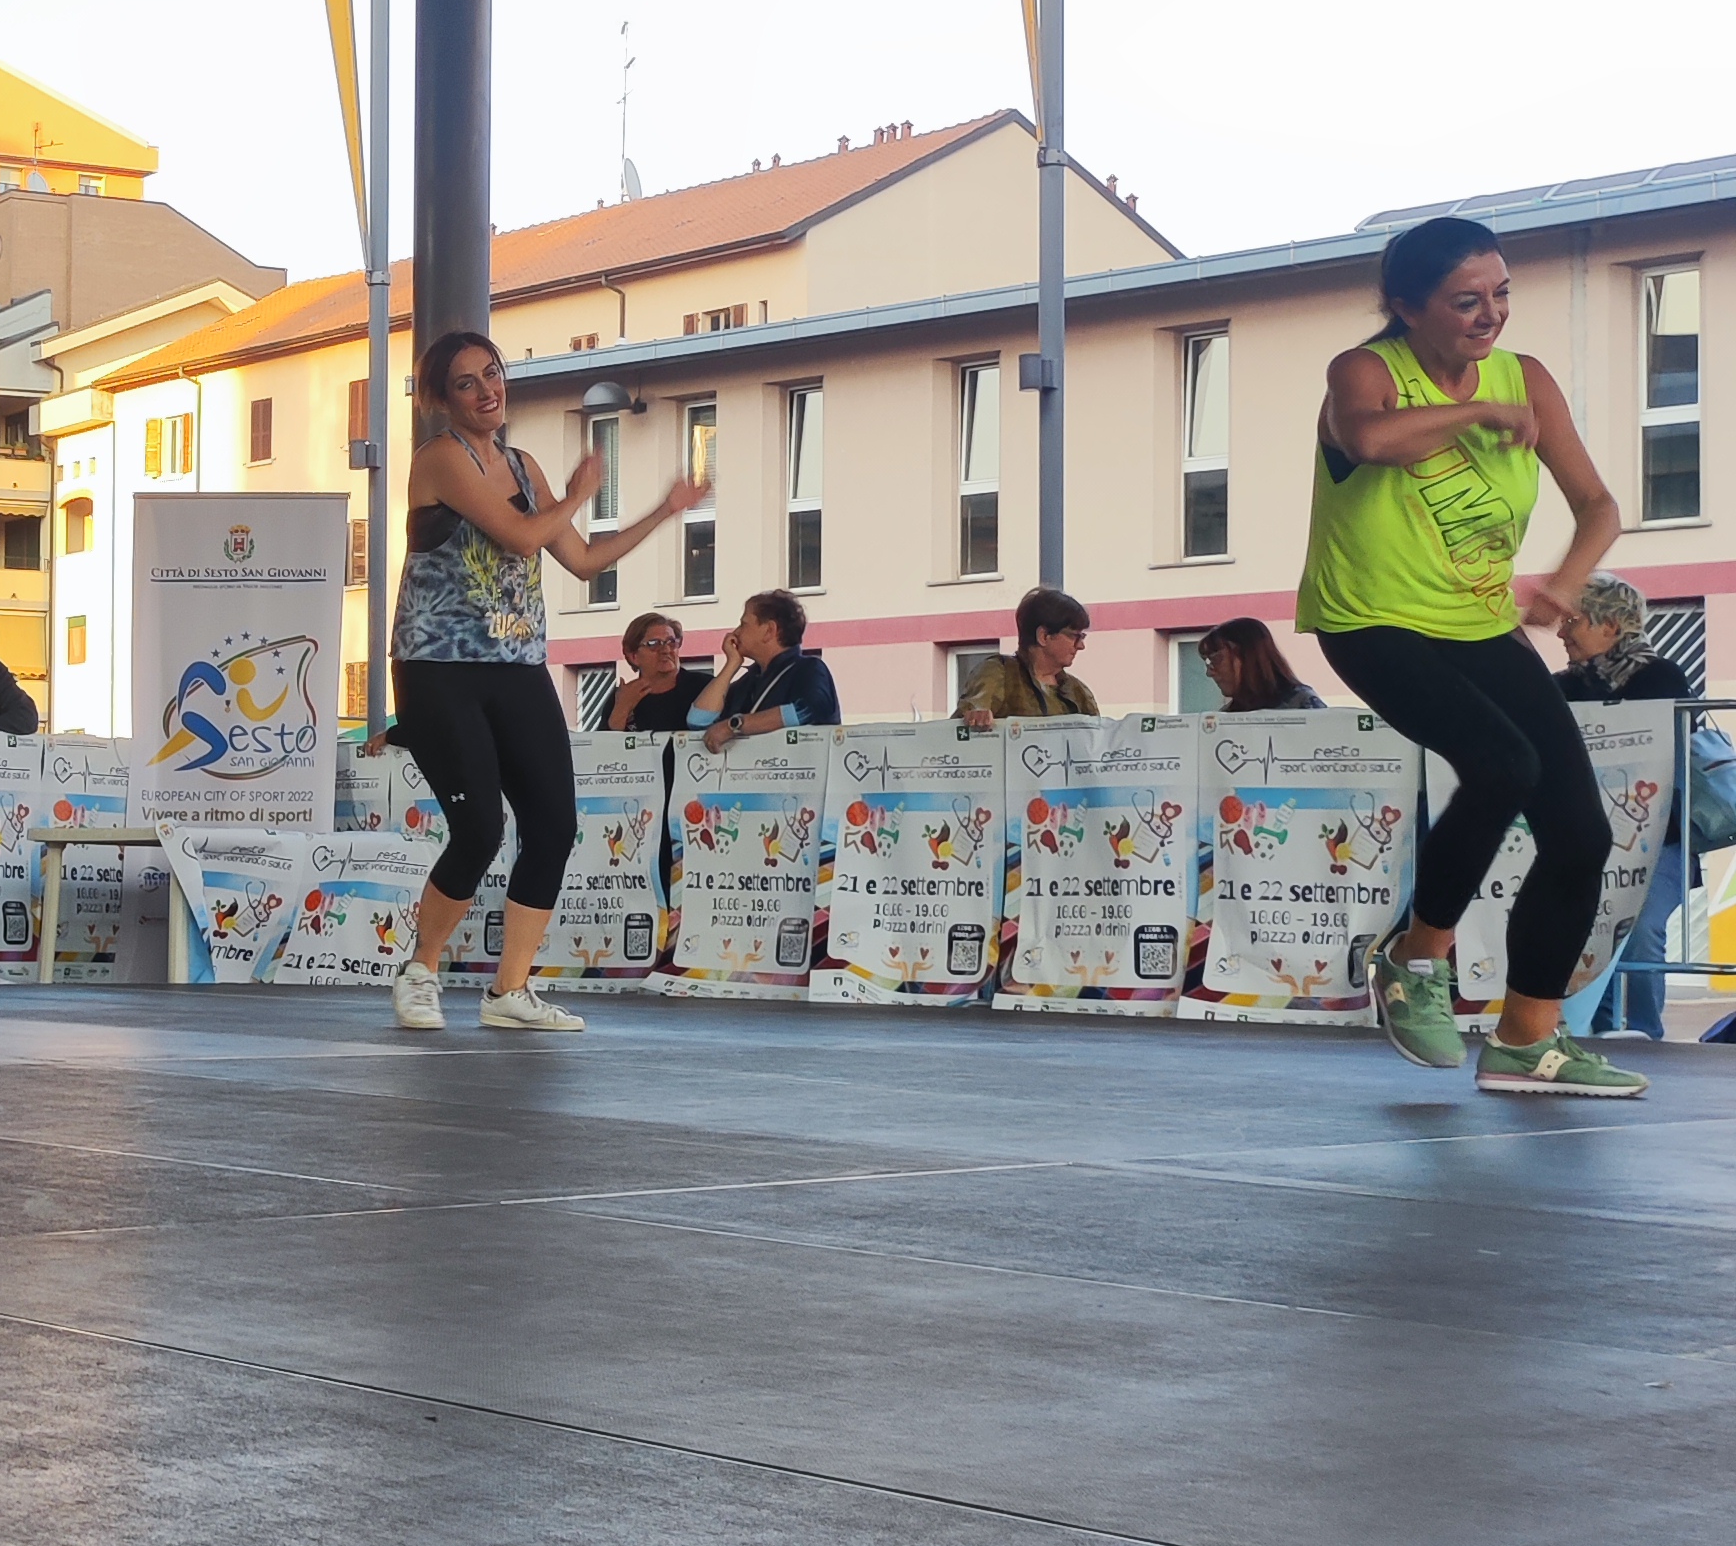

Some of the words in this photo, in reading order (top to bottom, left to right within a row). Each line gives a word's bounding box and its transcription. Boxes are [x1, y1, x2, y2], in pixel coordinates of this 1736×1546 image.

[1314, 746, 1359, 757] festa
[110, 765, 130, 775] fest
[141, 790, 201, 802] EUROPEAN
[204, 791, 227, 802] CITY
[230, 791, 246, 802] OF
[249, 791, 285, 802] SPORT
[287, 791, 314, 802] 2022
[142, 807, 188, 821] Vivere
[191, 811, 199, 821] a
[204, 808, 245, 822] ritmo
[249, 808, 264, 822] di
[266, 808, 313, 825] sport!
[71, 866, 78, 881] e
[80, 865, 94, 881] 22
[96, 865, 123, 883] sette
[566, 873, 583, 890] 22
[586, 872, 647, 890] settembre
[686, 871, 702, 889] 21
[706, 874, 714, 889] e
[718, 872, 734, 890] 22
[738, 873, 811, 892] settembre
[837, 874, 860, 893] 21
[866, 878, 877, 895] e
[882, 876, 898, 895] 22
[900, 877, 984, 897] settembre
[1026, 877, 1043, 896] 21
[1049, 880, 1058, 896] e
[1062, 877, 1079, 896] 22
[1084, 875, 1175, 896] settembre
[1218, 880, 1234, 900] 21
[1241, 883, 1251, 900] e
[1258, 881, 1282, 901] 22
[1289, 883, 1390, 904] settembre
[1491, 879, 1504, 899] e
[283, 953, 301, 969] 21
[306, 956, 314, 970] e
[317, 953, 336, 969] 22
[341, 958, 399, 977] settem
